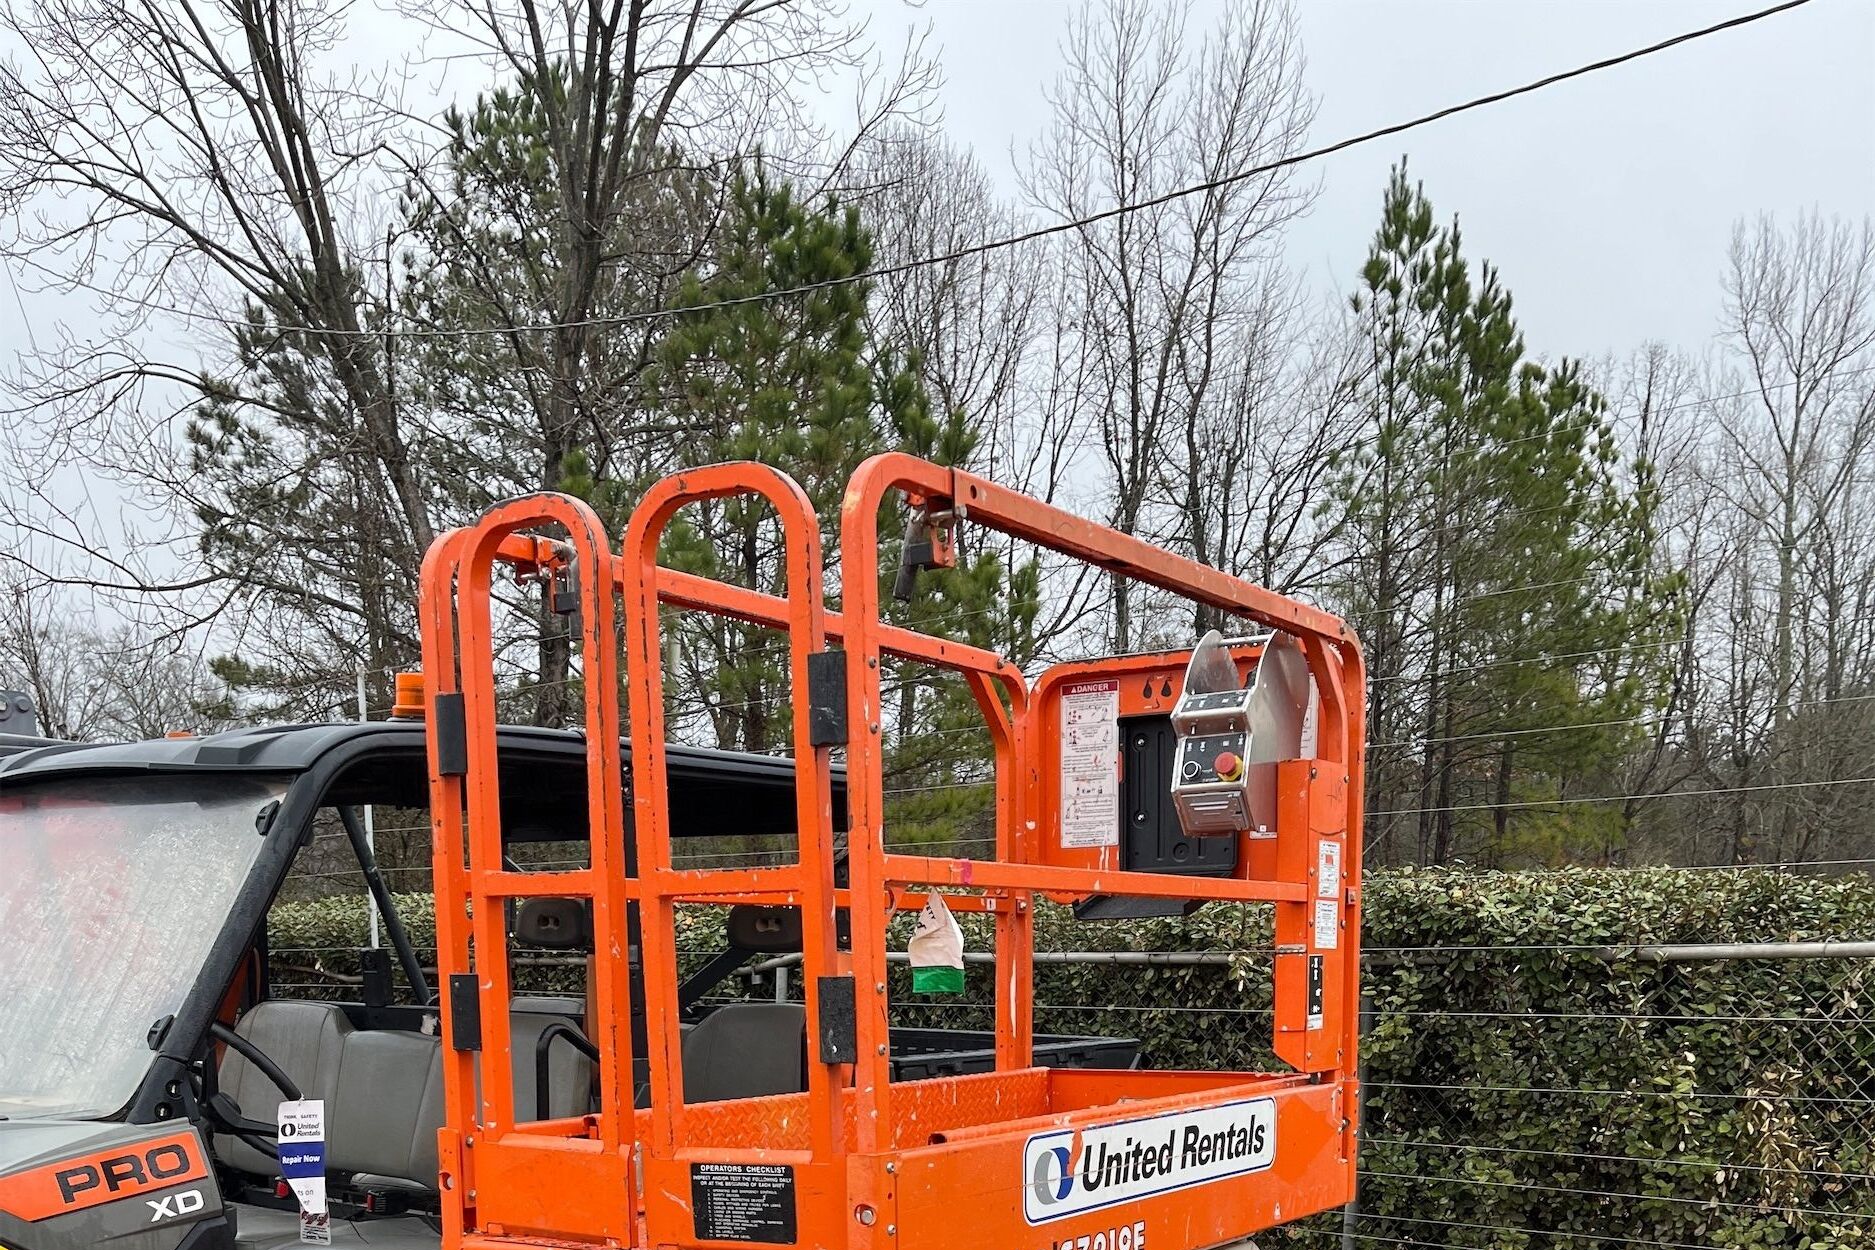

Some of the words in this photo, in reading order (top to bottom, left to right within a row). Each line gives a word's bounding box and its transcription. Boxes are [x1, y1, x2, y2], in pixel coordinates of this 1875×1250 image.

[1077, 683, 1109, 693] DANGER
[282, 1156, 302, 1166] Repair
[304, 1154, 320, 1162] Now
[1083, 1130, 1176, 1192] United
[1180, 1114, 1264, 1170] Rentals
[55, 1144, 190, 1204] PRO
[145, 1189, 205, 1223] XD
